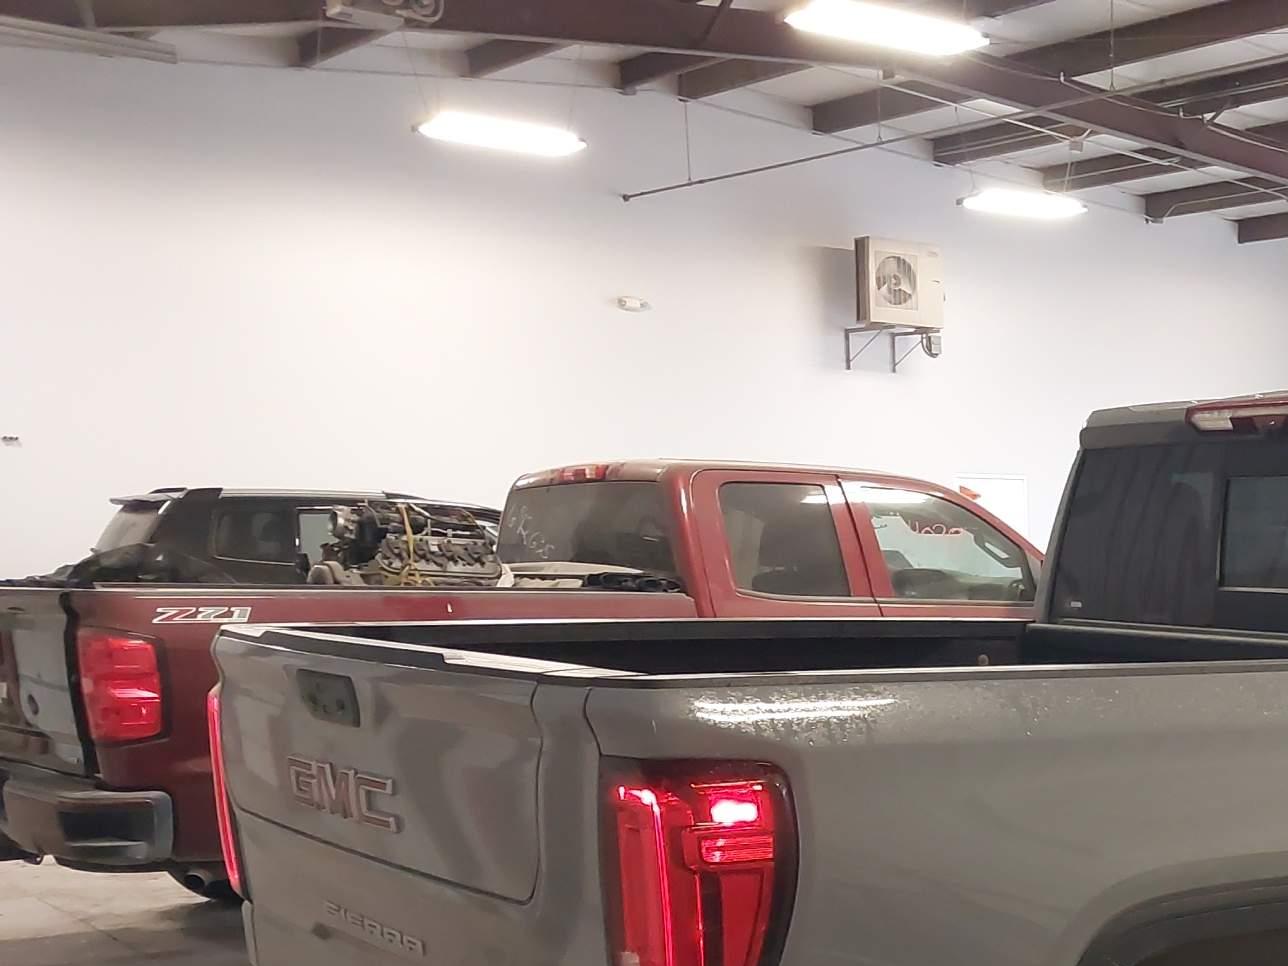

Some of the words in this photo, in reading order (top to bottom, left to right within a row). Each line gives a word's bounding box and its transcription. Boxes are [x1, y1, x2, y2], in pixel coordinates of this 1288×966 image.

[151, 606, 252, 624] Z71
[286, 754, 402, 834] GMC
[323, 900, 427, 958] SIERRA
